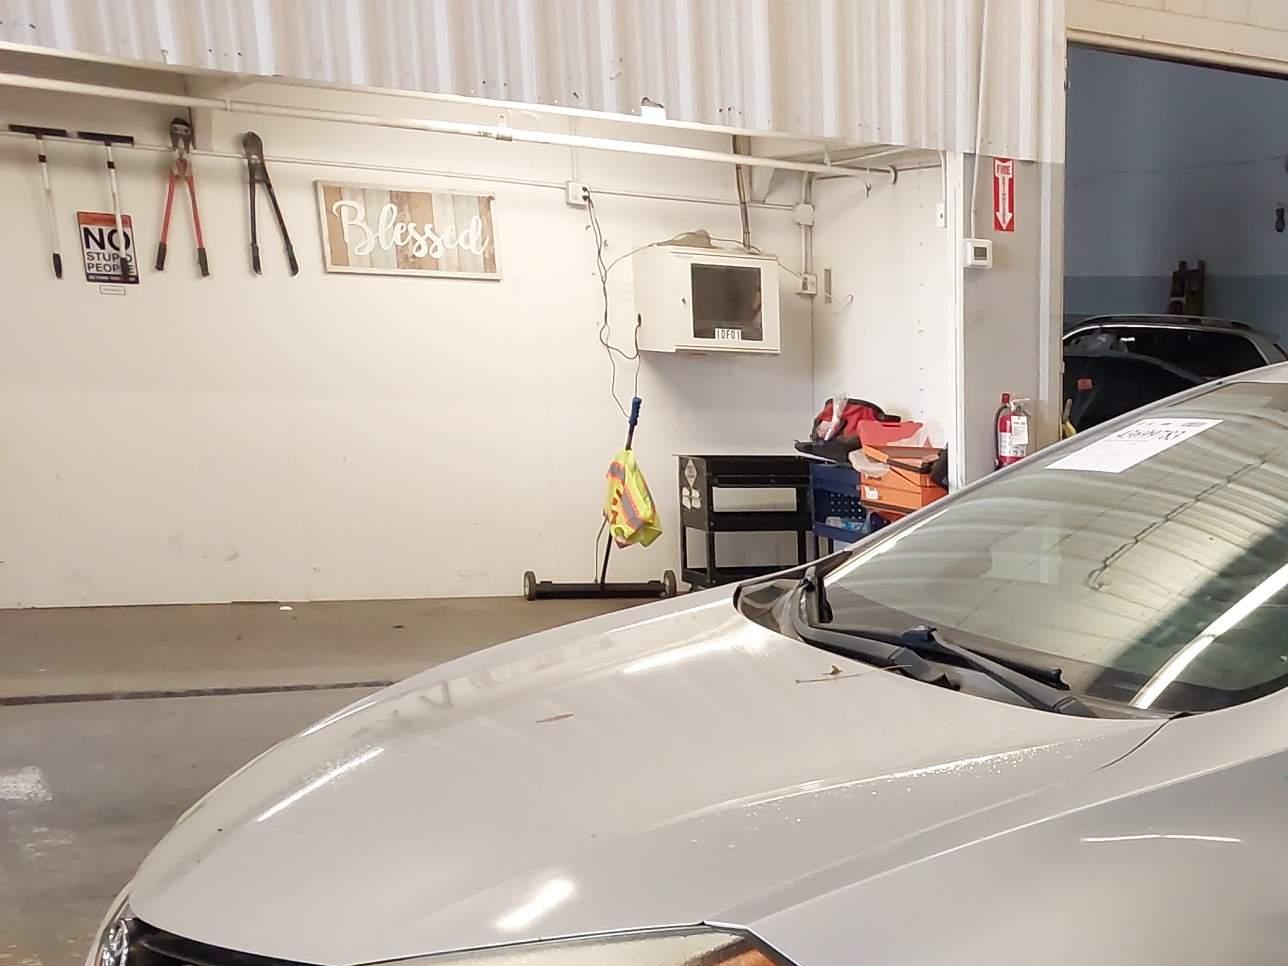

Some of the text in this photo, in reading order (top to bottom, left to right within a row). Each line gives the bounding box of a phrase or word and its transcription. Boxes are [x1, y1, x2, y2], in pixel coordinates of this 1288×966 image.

[332, 200, 490, 259] Blessed
[83, 227, 131, 251] NO
[86, 251, 133, 263] STUPD
[87, 262, 135, 274] PEOPE
